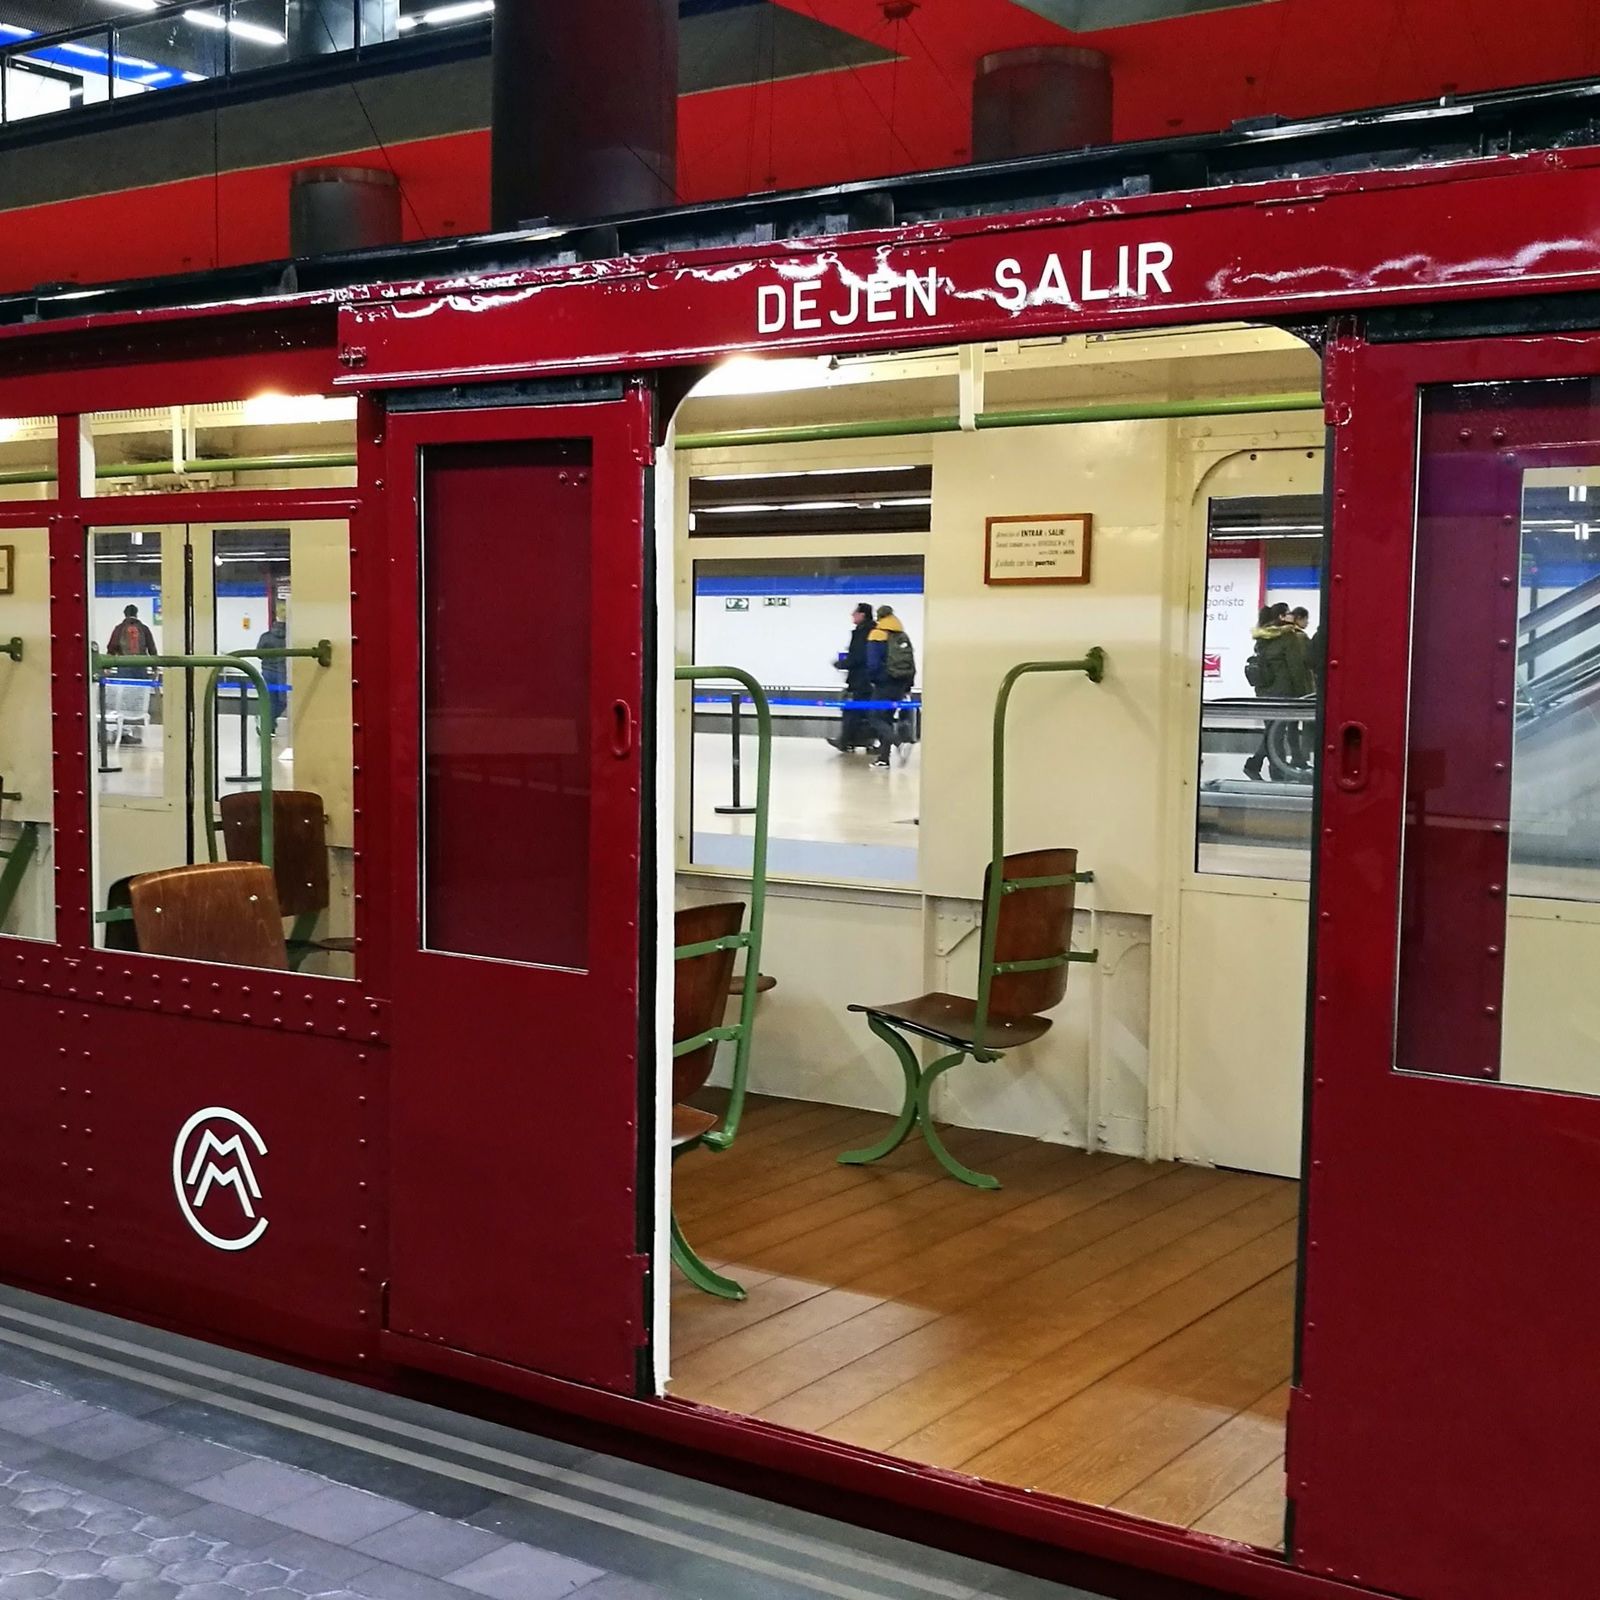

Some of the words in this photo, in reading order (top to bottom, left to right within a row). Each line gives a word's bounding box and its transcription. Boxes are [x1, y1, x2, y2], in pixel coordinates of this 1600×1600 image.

[757, 266, 937, 333] DEJEN
[994, 241, 1173, 309] SALIR
[1224, 582, 1234, 592] el
